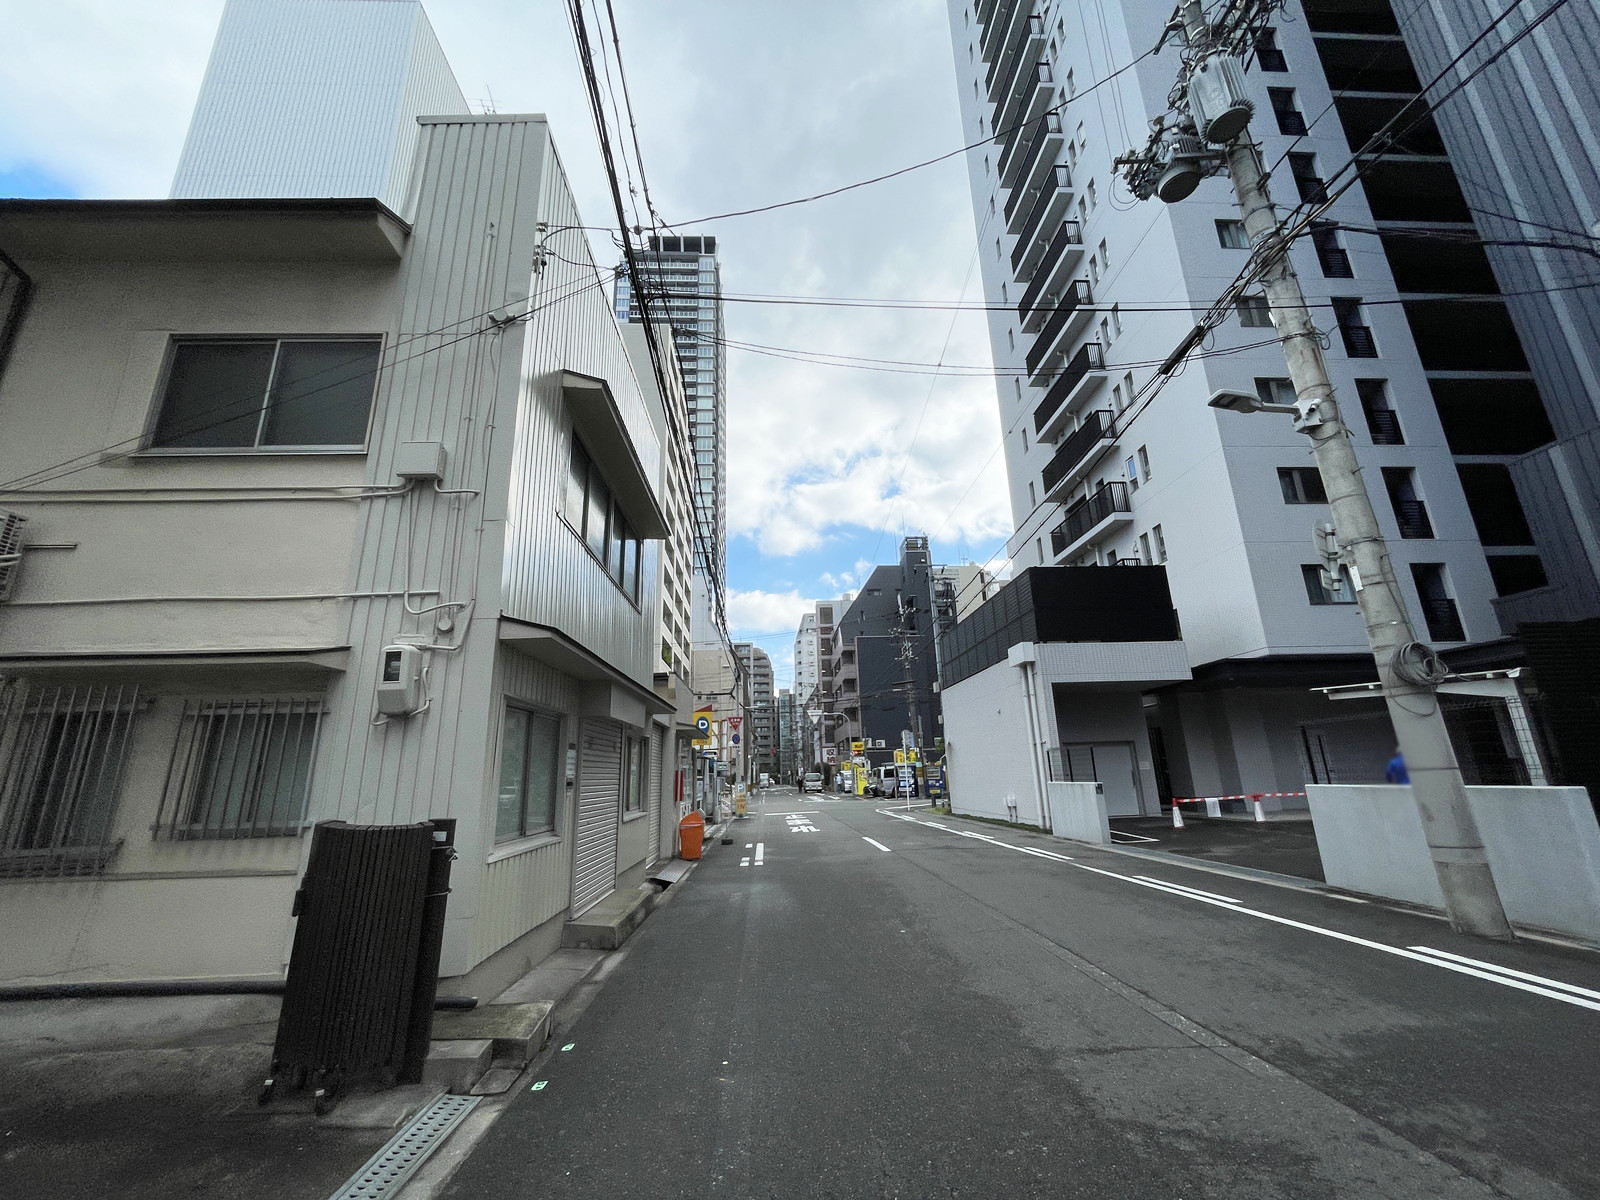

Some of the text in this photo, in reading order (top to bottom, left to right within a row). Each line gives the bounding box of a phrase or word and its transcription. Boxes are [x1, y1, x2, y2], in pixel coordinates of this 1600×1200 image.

[737, 784, 744, 793] P
[784, 814, 821, 833] 止まれ
